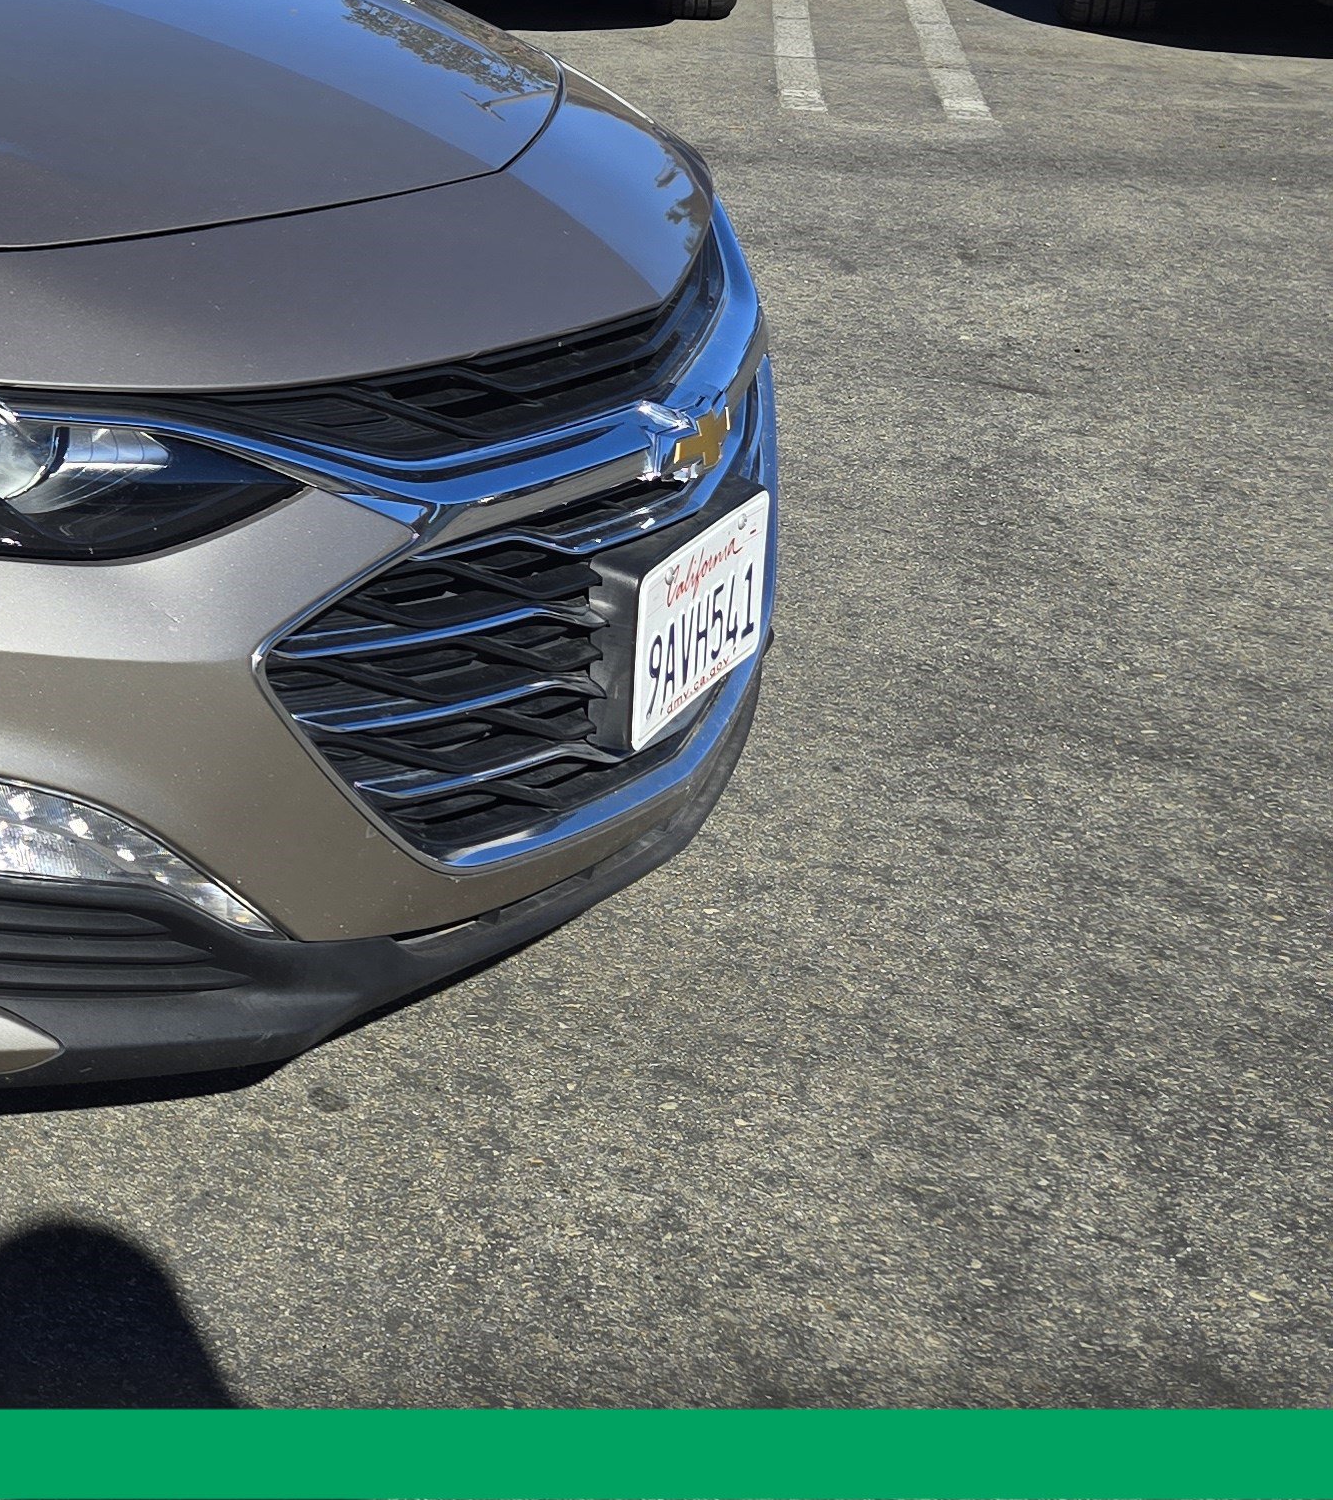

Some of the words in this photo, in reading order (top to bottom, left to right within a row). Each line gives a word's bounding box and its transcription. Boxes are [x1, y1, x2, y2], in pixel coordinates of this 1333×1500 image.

[667, 537, 743, 607] California
[646, 562, 755, 717] 9AVH541
[667, 656, 730, 714] dmv.ca.gov
